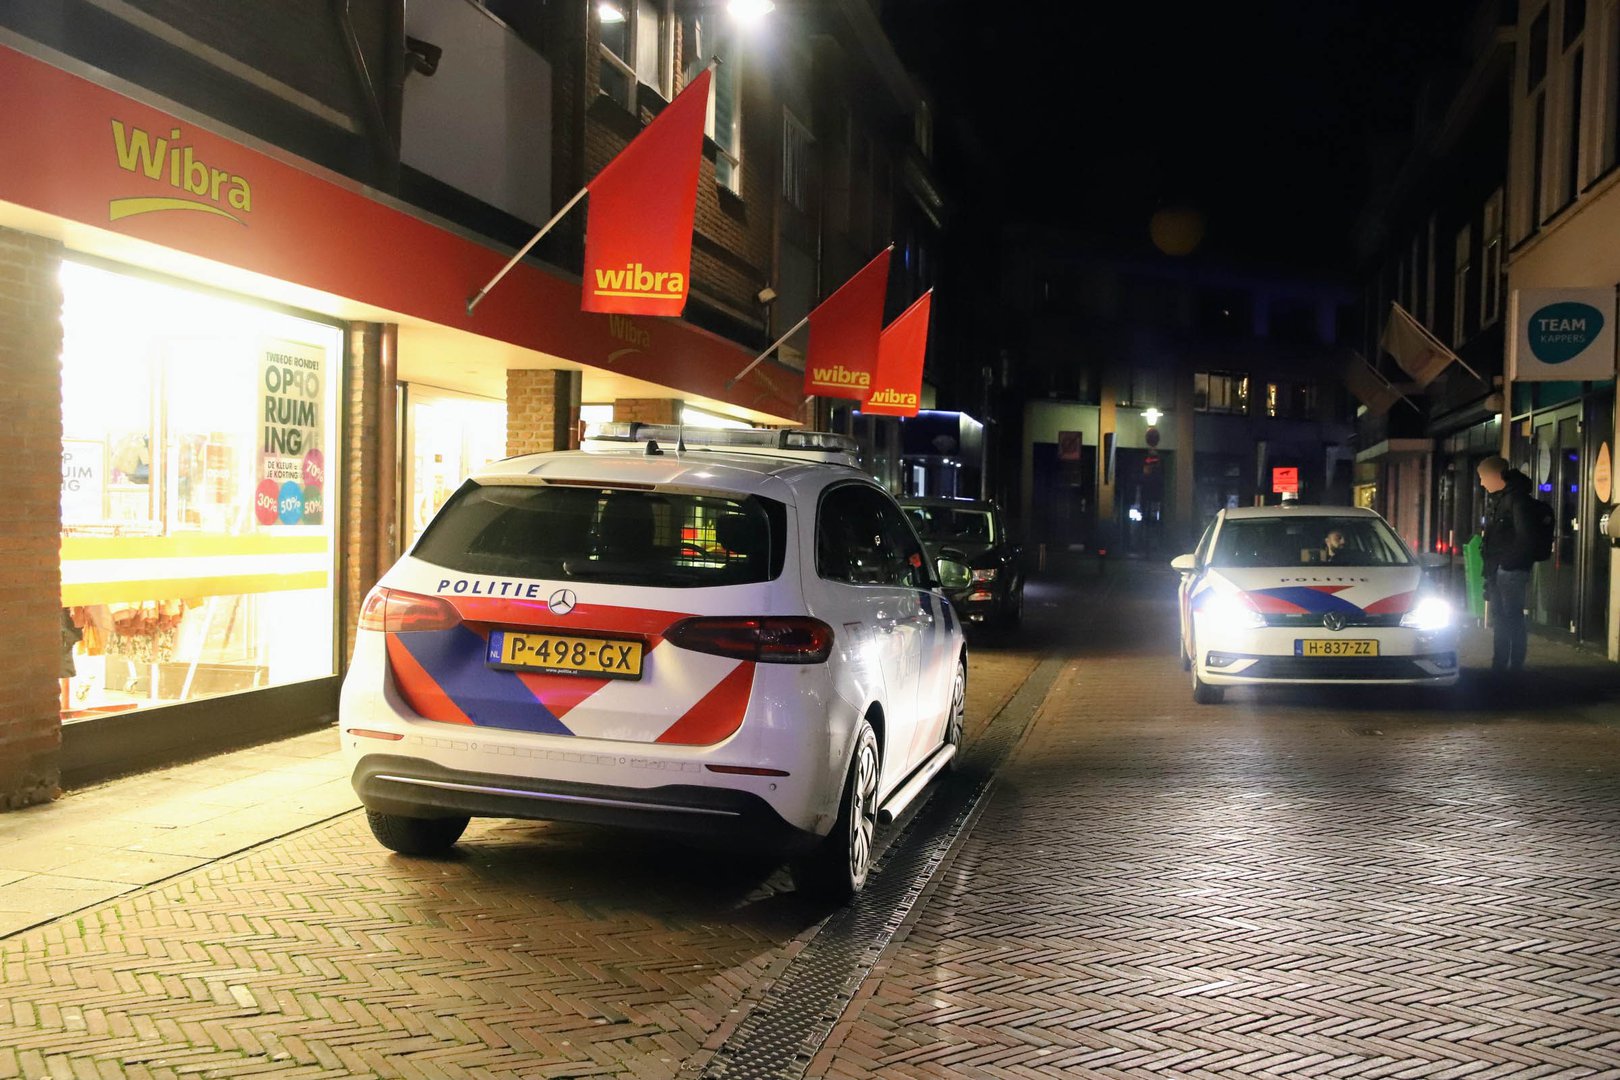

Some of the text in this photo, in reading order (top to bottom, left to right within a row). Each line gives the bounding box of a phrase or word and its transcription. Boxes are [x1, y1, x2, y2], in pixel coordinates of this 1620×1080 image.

[111, 119, 252, 212] Wibra
[595, 263, 684, 292] wibra
[1539, 319, 1586, 332] TEAM
[1541, 334, 1586, 344] KAPPERS
[266, 352, 319, 370] TWEEDE RONDE!
[813, 365, 871, 385] wibra
[265, 395, 315, 428] RUIM
[264, 426, 302, 456] ING
[267, 461, 275, 469] DE
[276, 462, 293, 470] KLEUR
[306, 460, 324, 482] 70%
[267, 470, 299, 480] JE KORTING
[258, 492, 278, 512] 30%
[281, 496, 301, 514] 50%
[304, 499, 324, 514] 50%
[437, 579, 540, 598] POLITIE
[490, 650, 500, 659] NL
[510, 637, 632, 670] P-498-GX
[1309, 642, 1371, 654] H-837-ZZ
